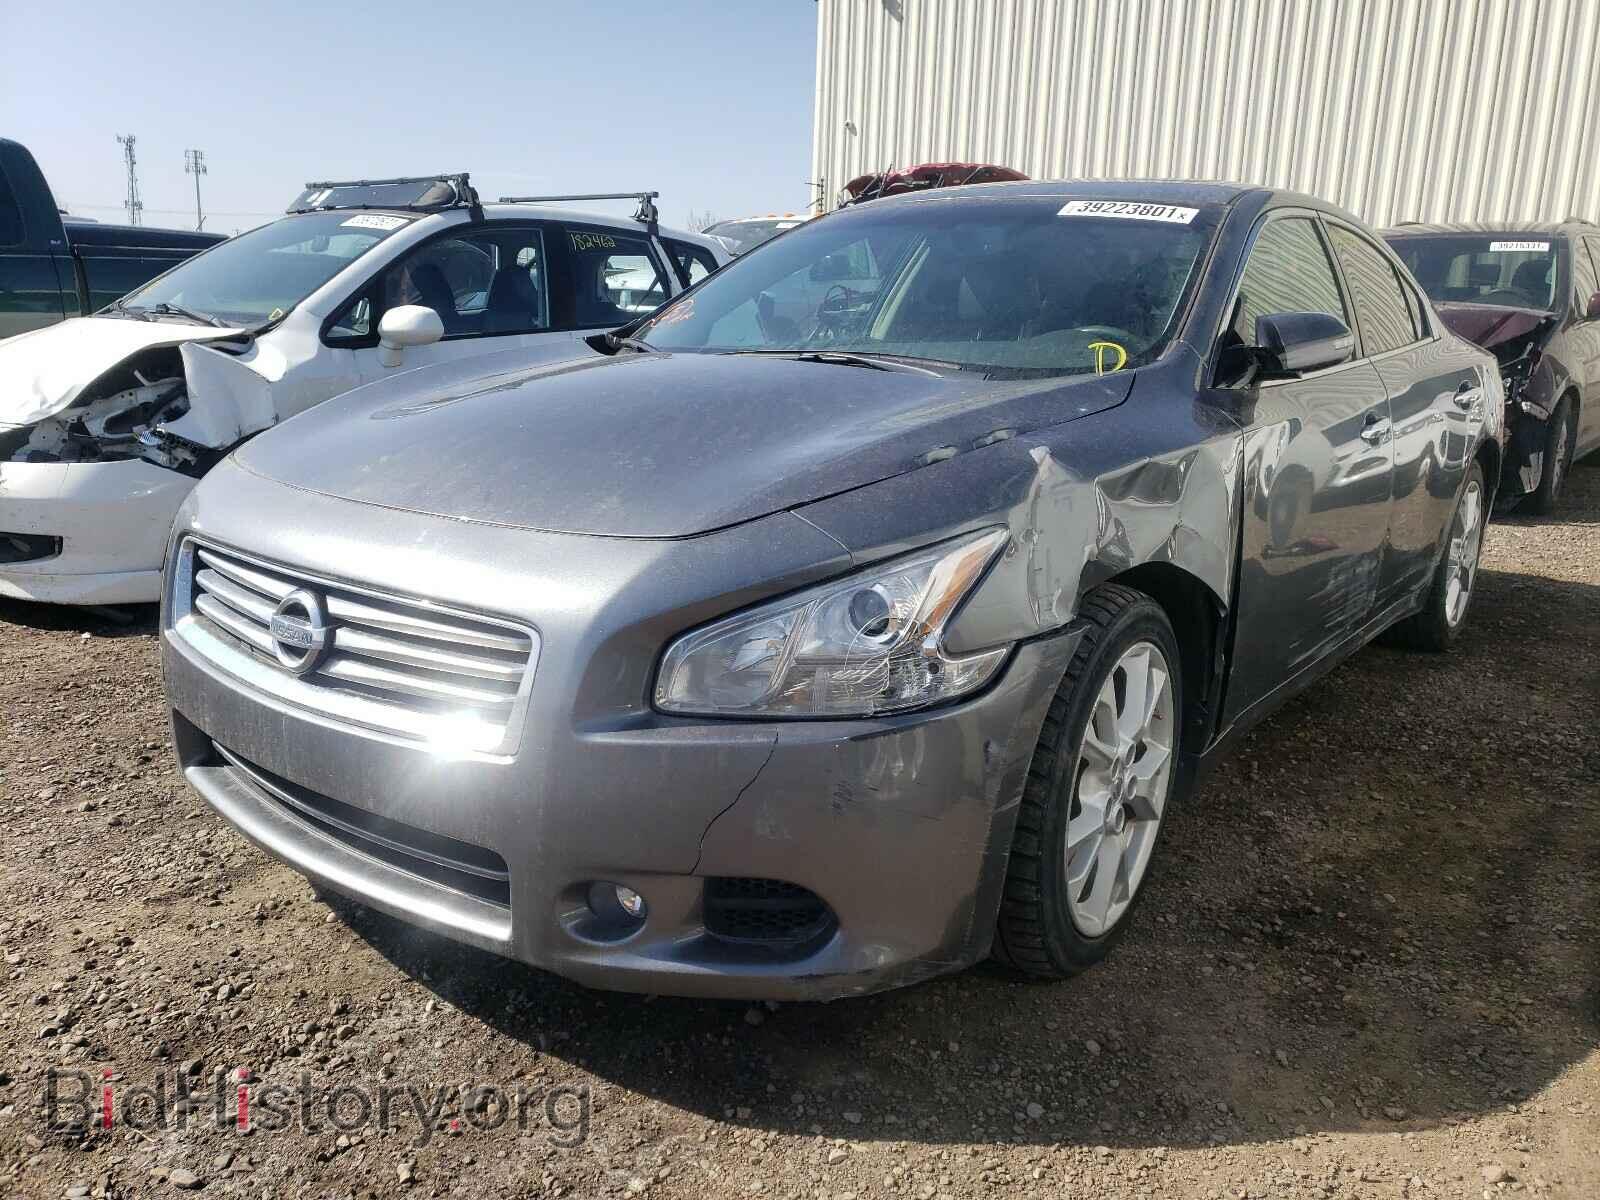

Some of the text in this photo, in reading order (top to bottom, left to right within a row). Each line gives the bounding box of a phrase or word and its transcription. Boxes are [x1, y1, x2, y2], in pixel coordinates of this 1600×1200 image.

[1077, 201, 1178, 219] 39223801
[1088, 342, 1127, 377] D
[269, 617, 313, 646] NISSAN
